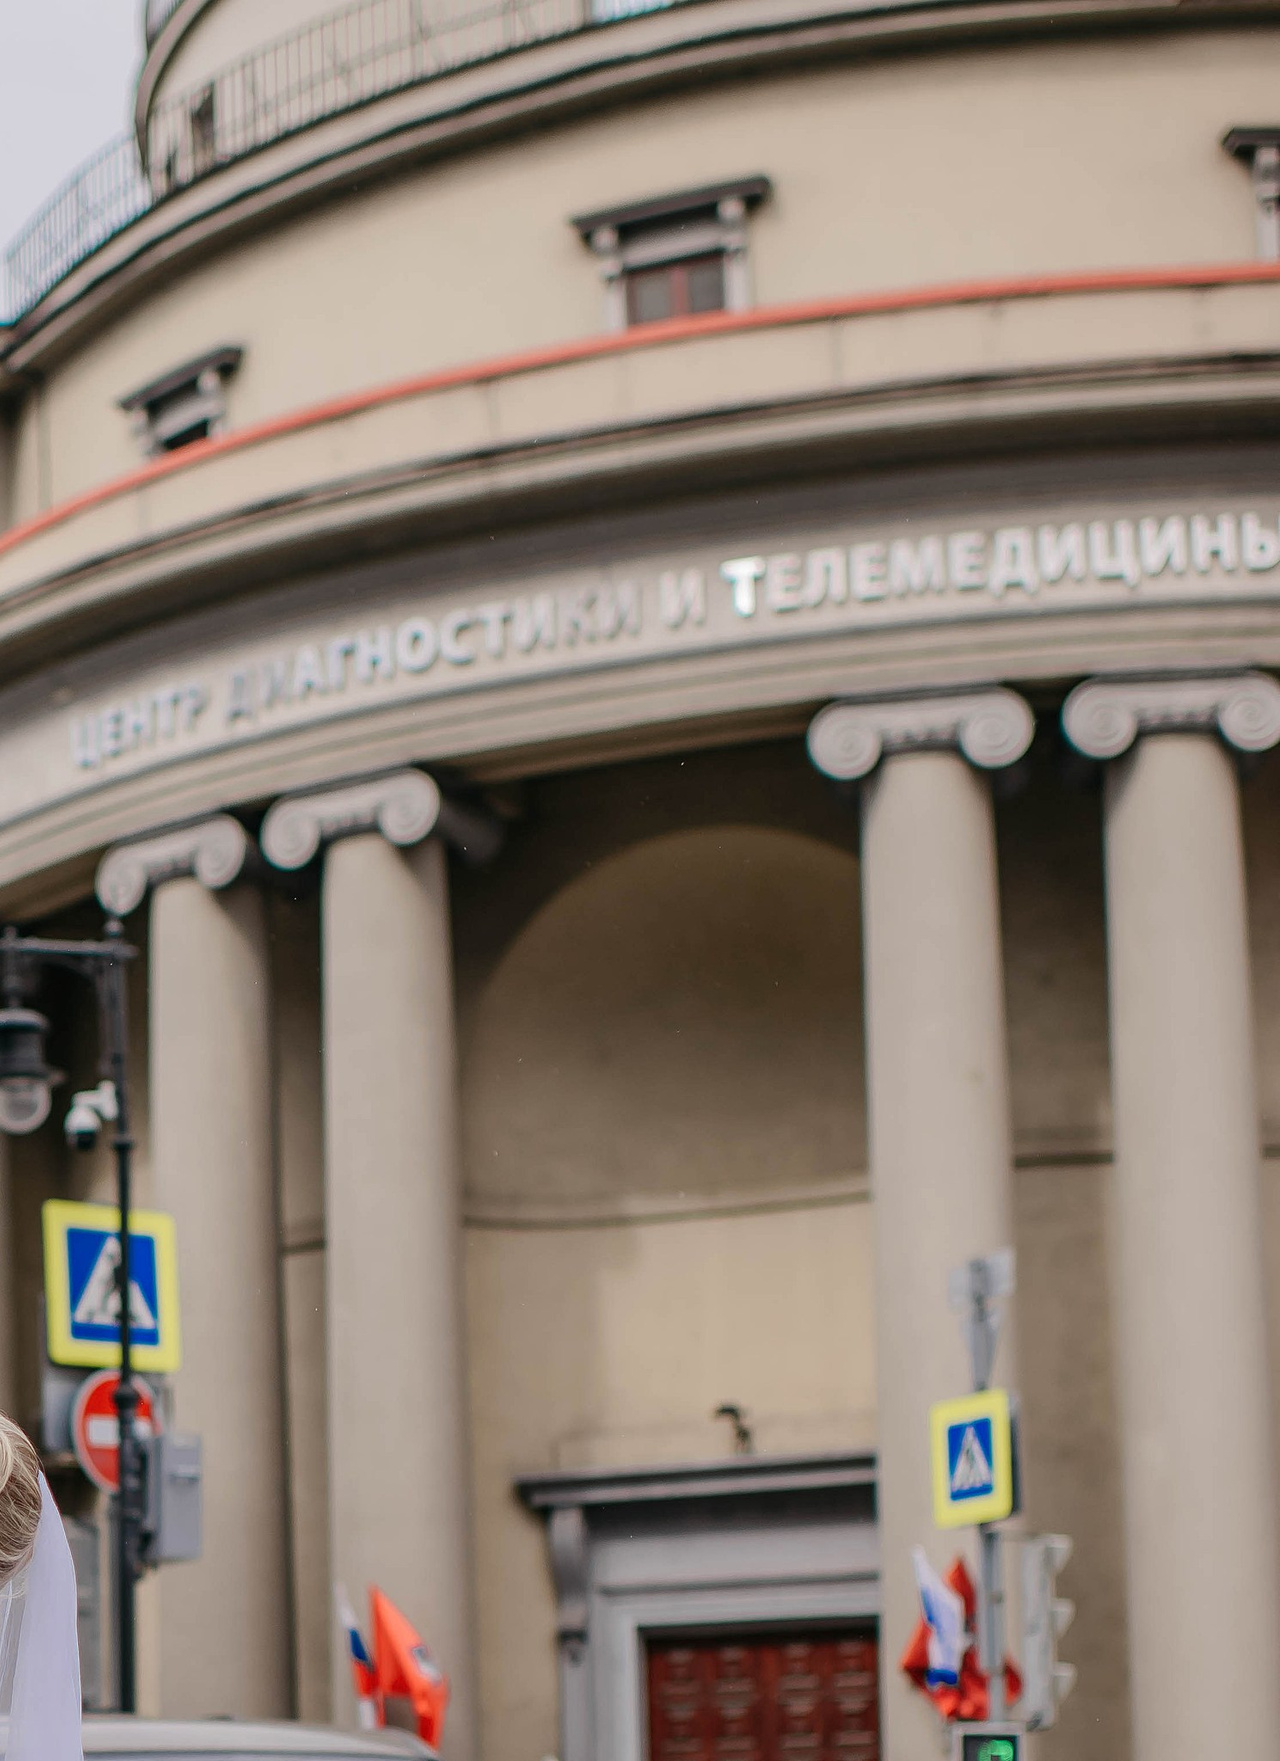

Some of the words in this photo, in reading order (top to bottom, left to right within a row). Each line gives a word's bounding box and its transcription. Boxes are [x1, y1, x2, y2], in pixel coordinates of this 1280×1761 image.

[70, 679, 207, 769] ЦЕНТР
[225, 578, 641, 727] ДИАГНОСТИКИ
[660, 568, 706, 629] И
